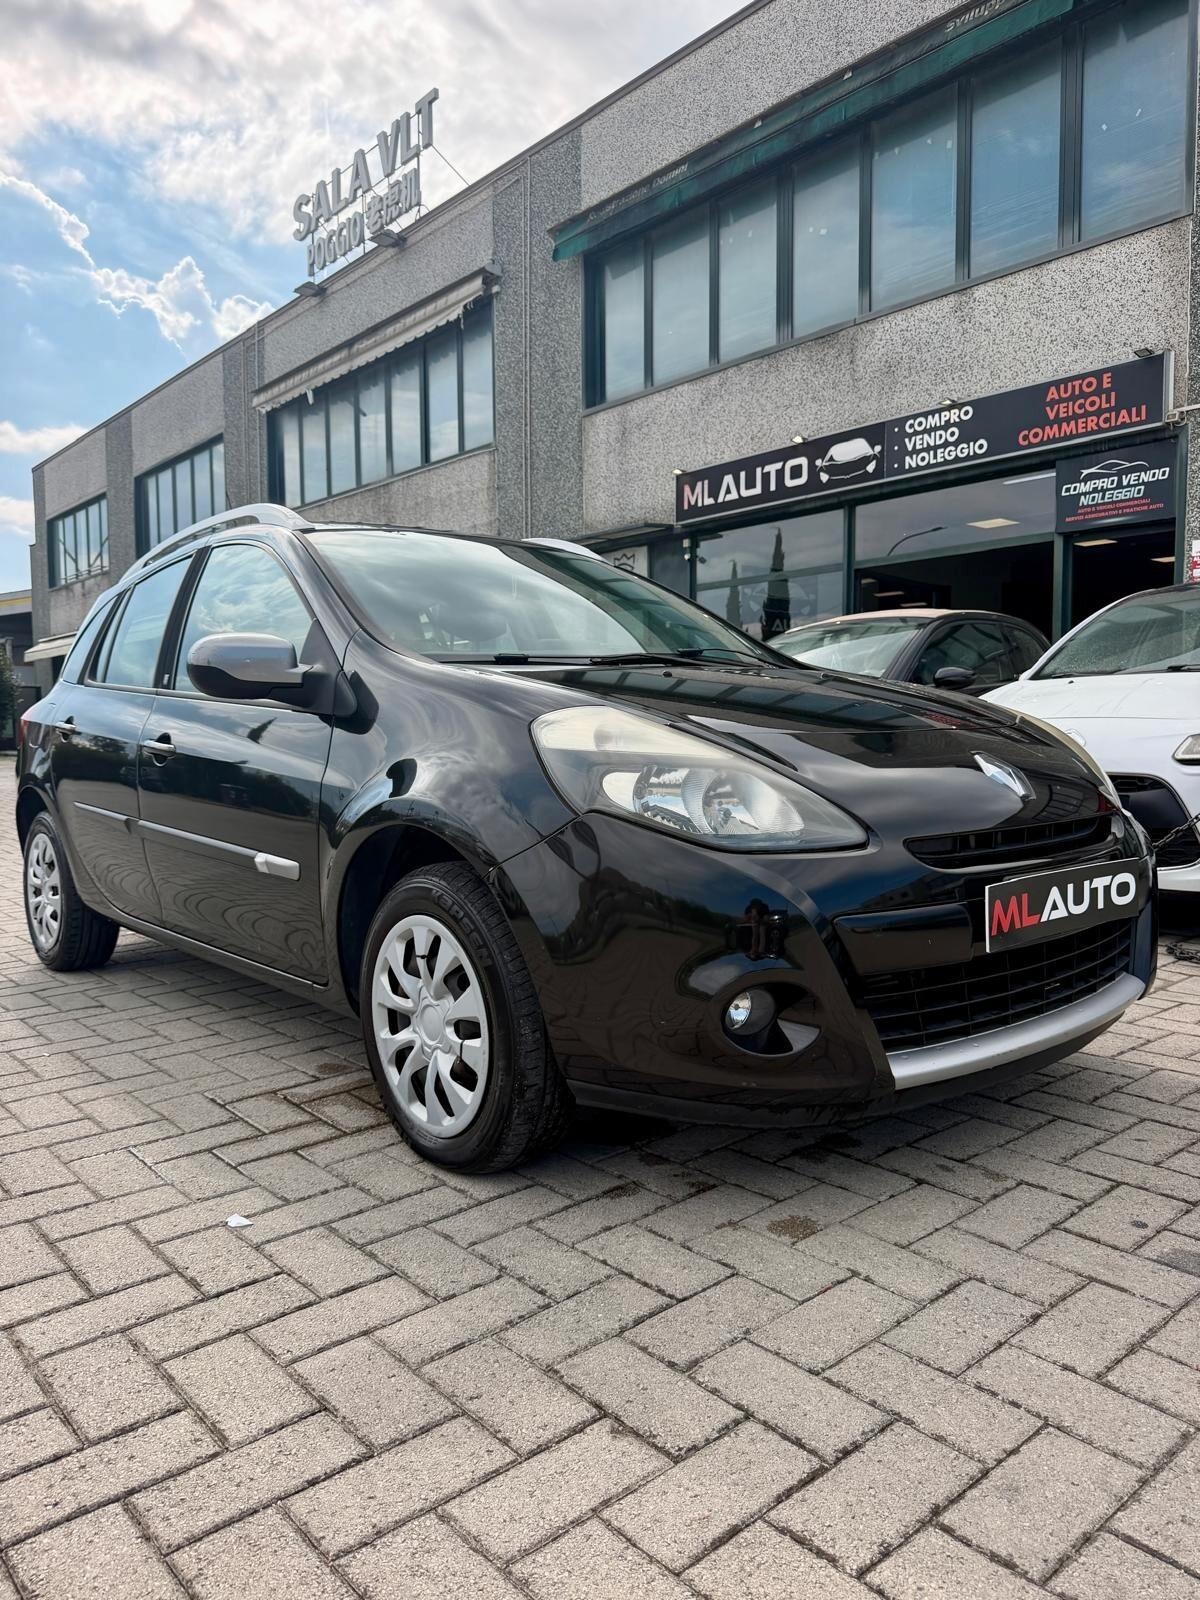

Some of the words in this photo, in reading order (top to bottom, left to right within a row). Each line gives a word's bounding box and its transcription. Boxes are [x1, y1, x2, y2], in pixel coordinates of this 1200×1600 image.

[293, 148, 371, 241] SALA
[376, 87, 439, 178] VLT
[307, 211, 365, 277] POGGIO
[1045, 376, 1098, 402] AUTO
[1102, 372, 1112, 389] E
[904, 405, 974, 434] COMPRO
[1045, 391, 1116, 420] VEICOLI
[904, 426, 960, 452] VENDO
[1018, 404, 1147, 446] COMMERCIALI
[904, 438, 988, 470] NOLEGGIO
[1061, 476, 1118, 497] COMPRO
[1121, 467, 1170, 487] VENDO
[1079, 485, 1145, 507] NOLEGGIO
